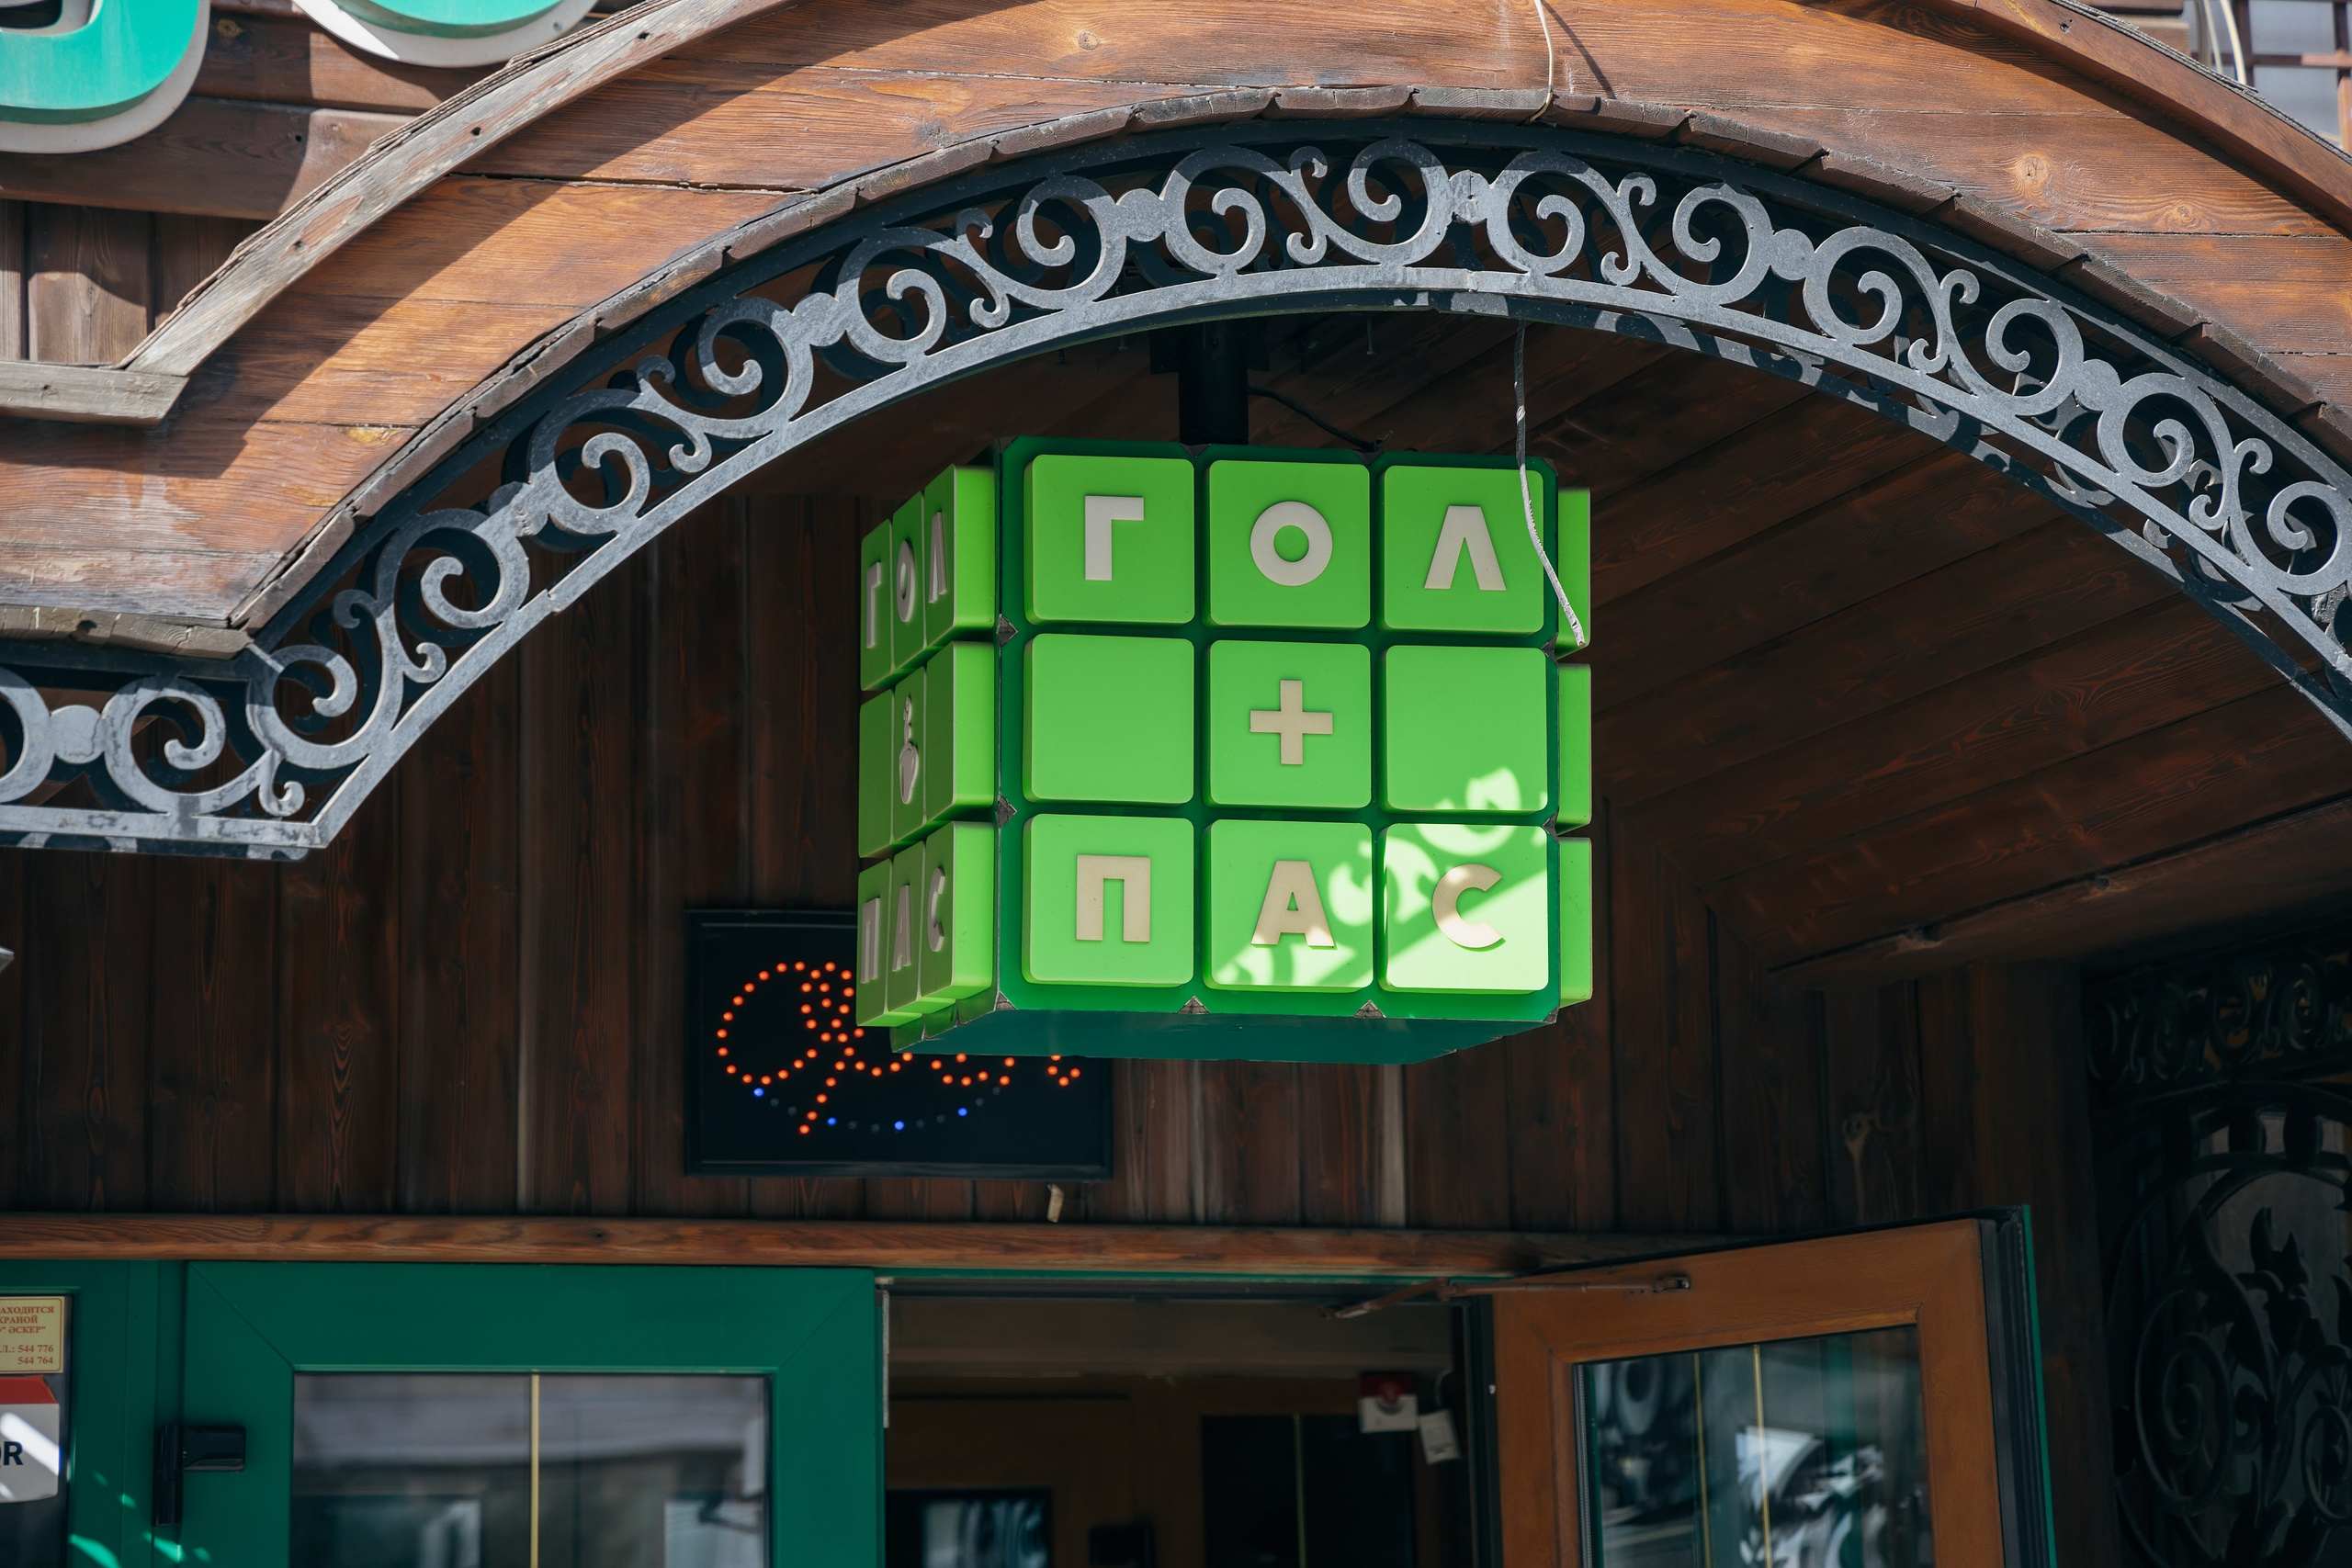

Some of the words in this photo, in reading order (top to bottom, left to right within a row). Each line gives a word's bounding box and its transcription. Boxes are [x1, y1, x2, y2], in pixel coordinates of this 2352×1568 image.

[865, 511, 948, 649] ГОЛ
[1084, 494, 1507, 591] ГОЛ
[861, 866, 946, 985] ПАС
[1076, 854, 1507, 953] ПАС
[17, 1345, 34, 1353] 544
[38, 1344, 54, 1353] 776
[17, 1357, 34, 1365] 544
[38, 1357, 54, 1365] 764
[0, 1441, 24, 1467] R
